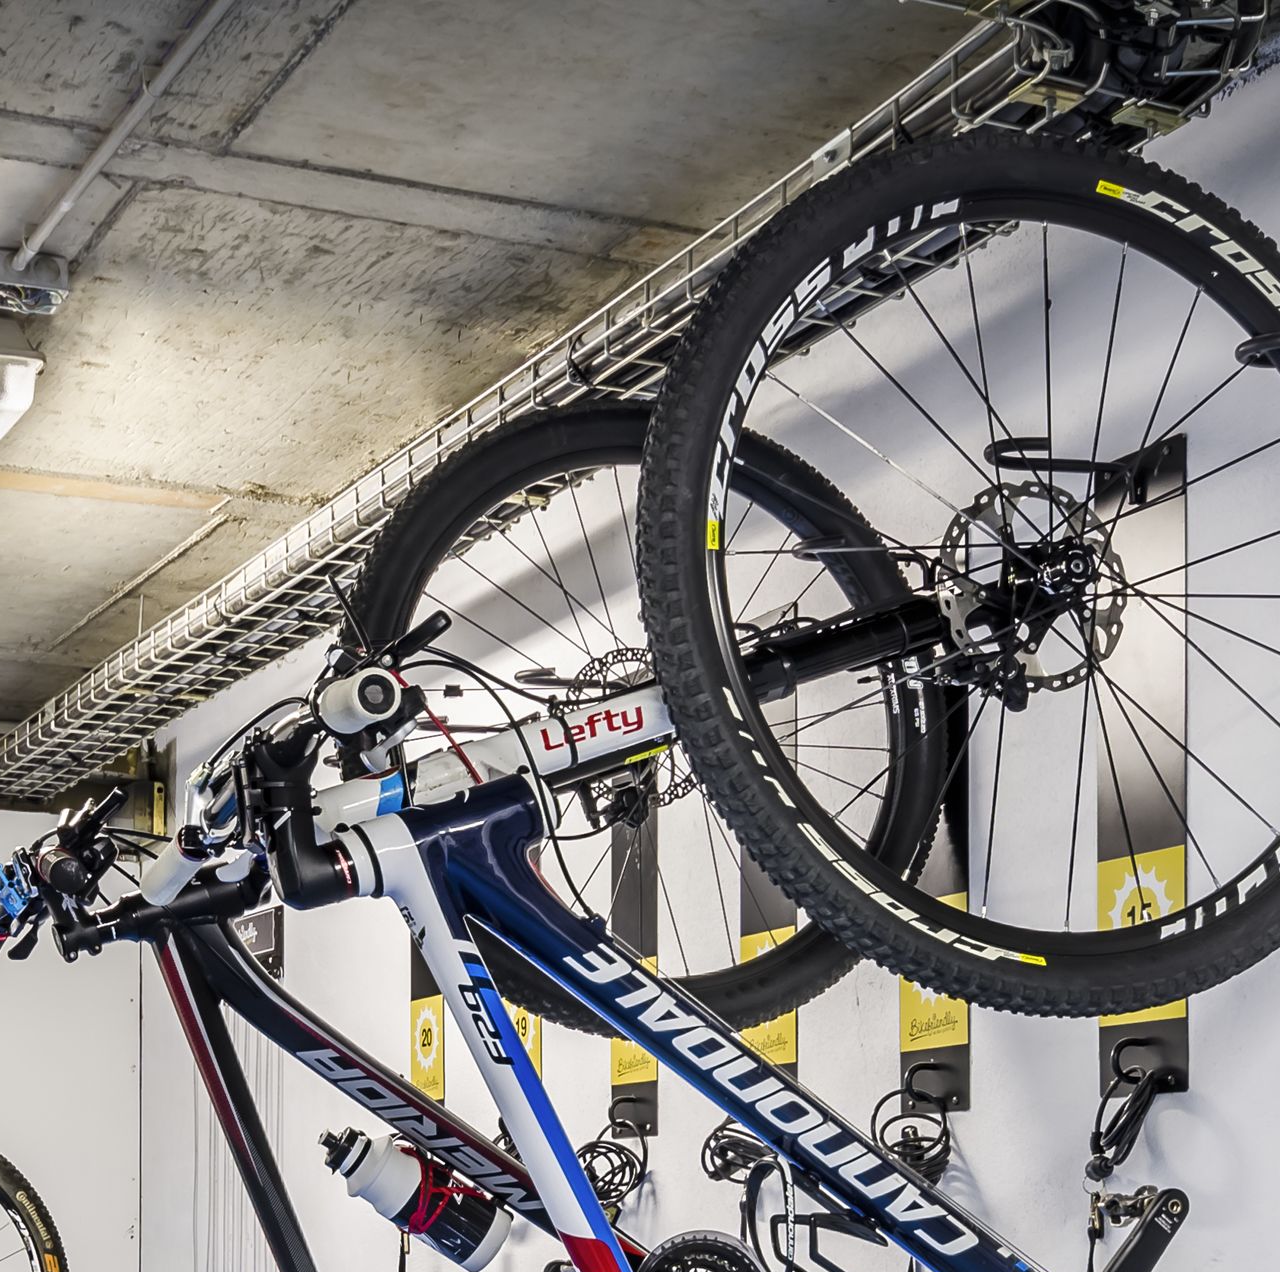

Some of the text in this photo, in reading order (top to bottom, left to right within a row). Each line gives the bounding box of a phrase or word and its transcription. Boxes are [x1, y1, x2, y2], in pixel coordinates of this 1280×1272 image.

[540, 706, 643, 751] Lefty
[421, 1028, 433, 1048] 20
[516, 1016, 527, 1037] 19
[563, 943, 979, 1254] CANNONDALE
[296, 1048, 545, 1211] MERIDA
